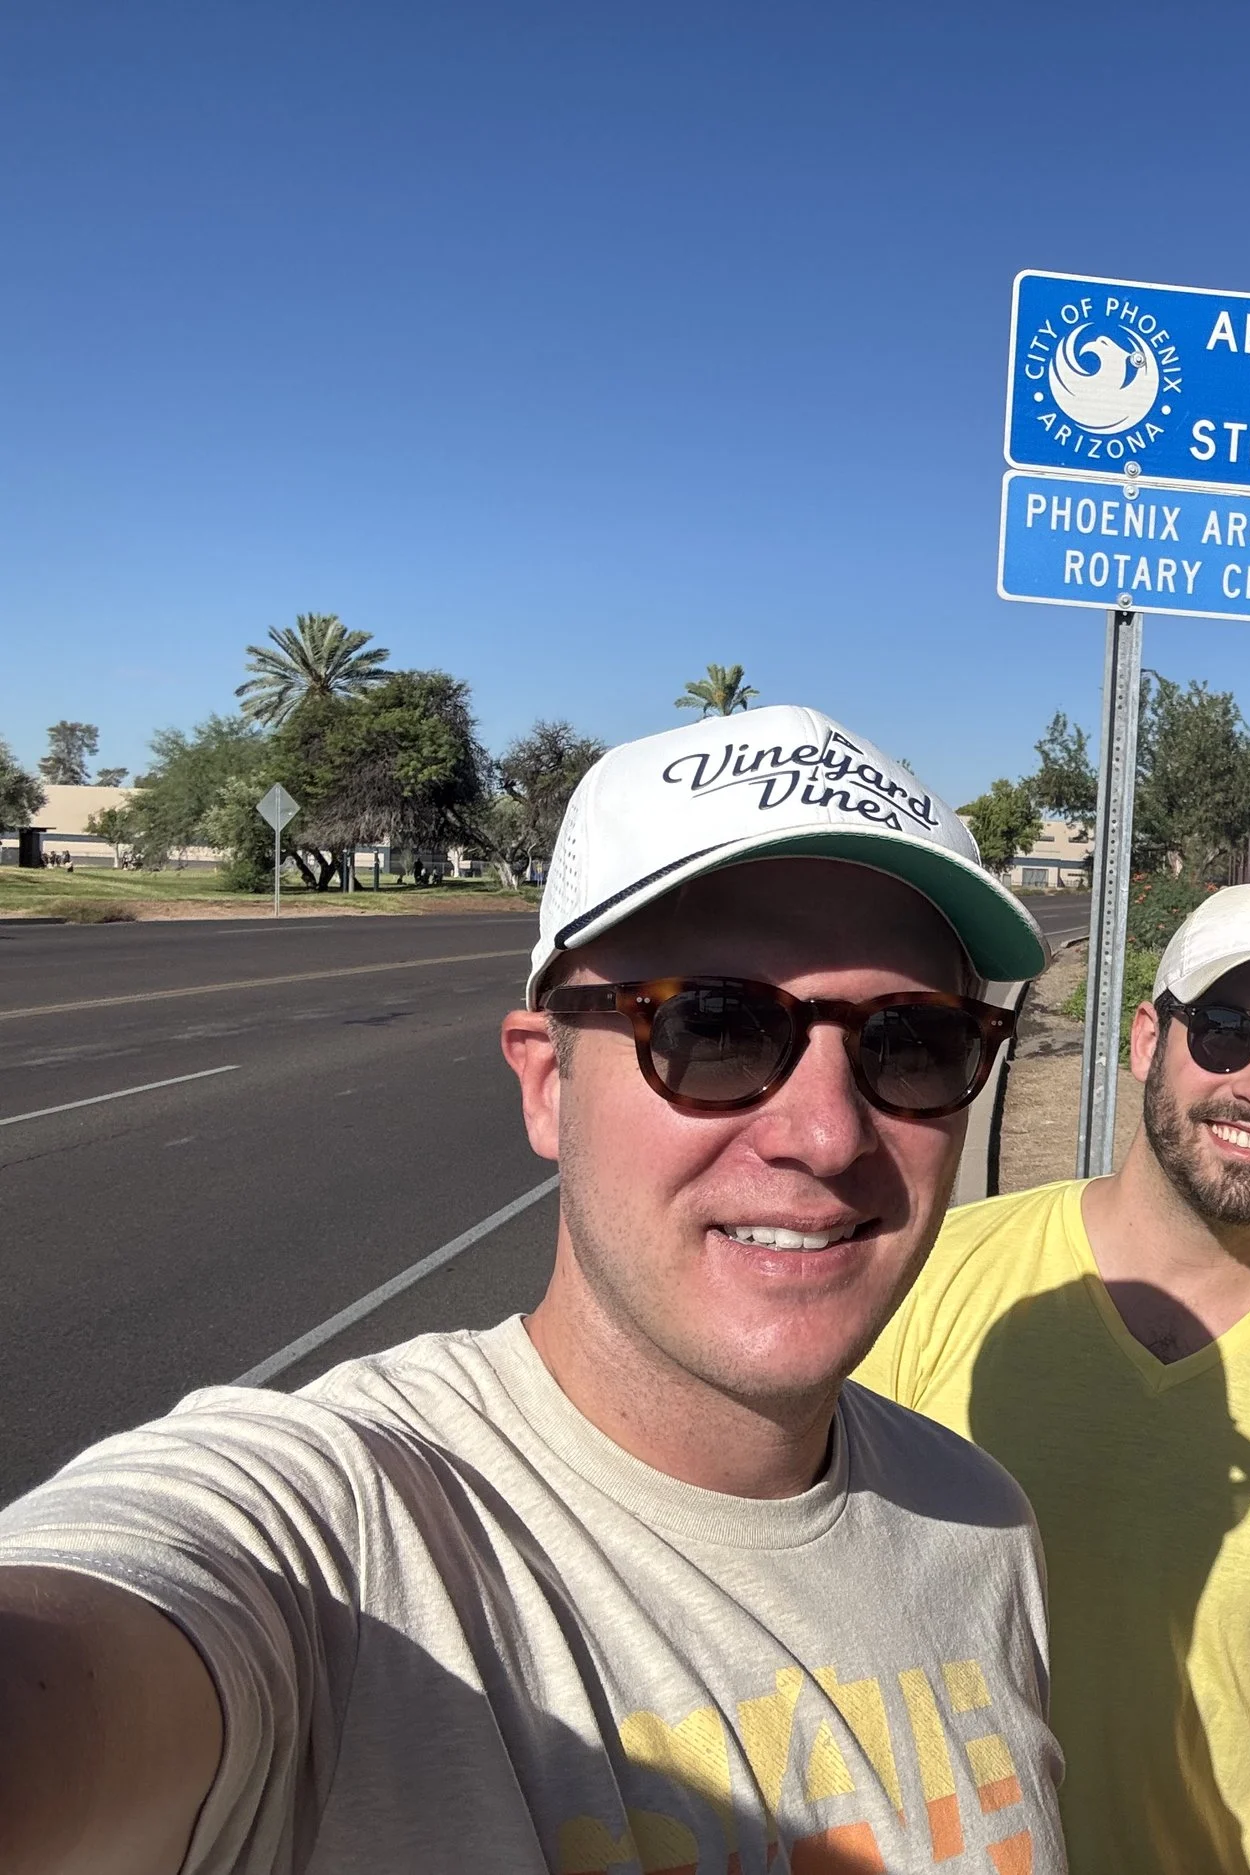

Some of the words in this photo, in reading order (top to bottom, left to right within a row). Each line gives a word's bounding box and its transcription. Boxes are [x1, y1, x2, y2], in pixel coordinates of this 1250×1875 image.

[1025, 319, 1058, 380] CITY
[1060, 297, 1093, 325] OF
[1105, 297, 1182, 394] PHOENIX
[1037, 412, 1165, 459] ARIZONA
[1026, 493, 1181, 542] PHOENIX
[1064, 549, 1202, 594] ROTARY
[662, 742, 939, 826] Vineyard
[748, 770, 904, 832] Vines
